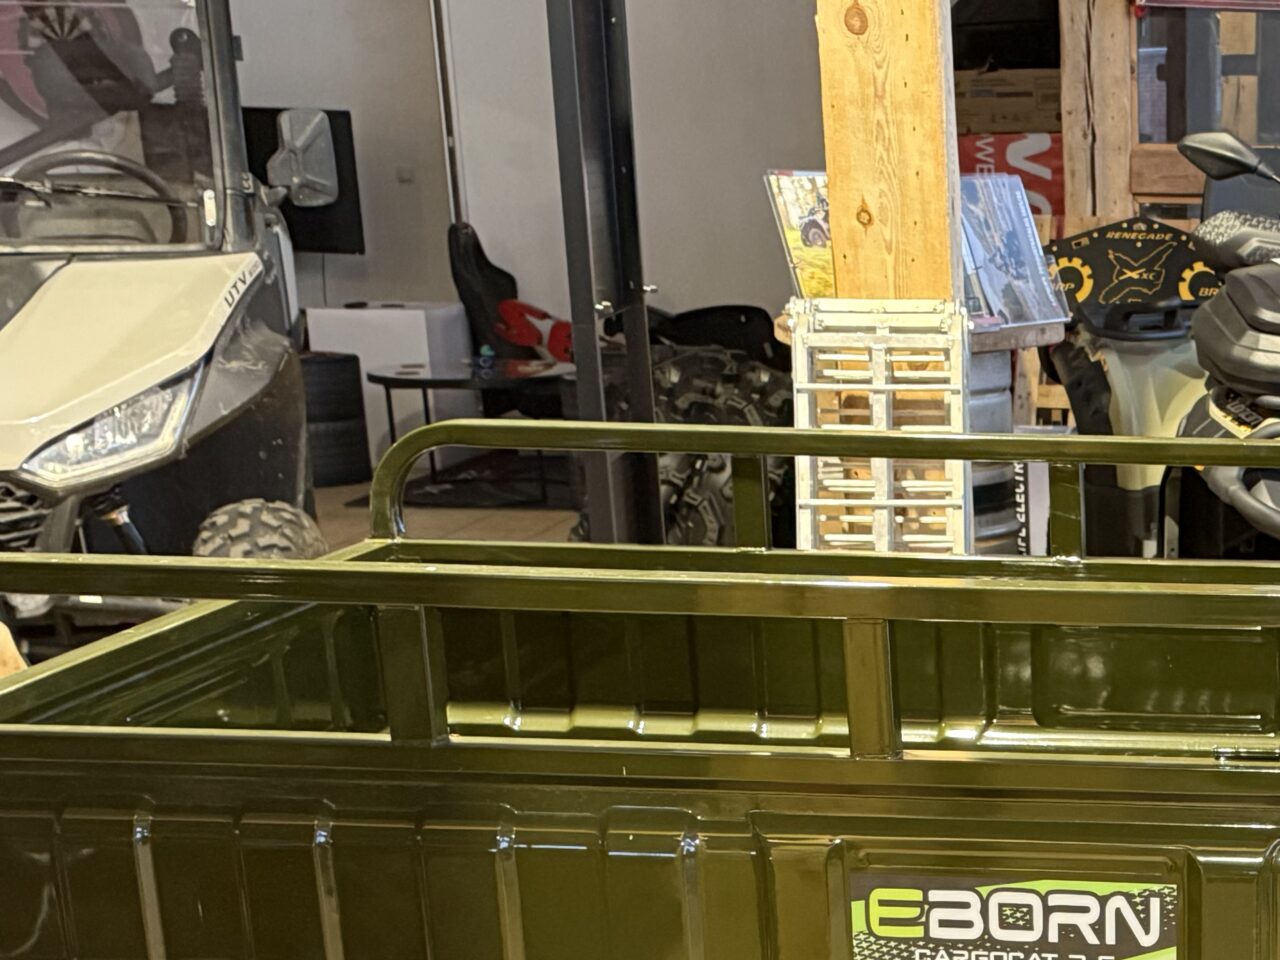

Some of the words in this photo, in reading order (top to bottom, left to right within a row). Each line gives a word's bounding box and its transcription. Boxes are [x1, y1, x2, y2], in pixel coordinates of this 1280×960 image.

[1105, 231, 1174, 241] RENEGADE
[223, 270, 247, 308] UTV
[869, 887, 1161, 947] EBORN
